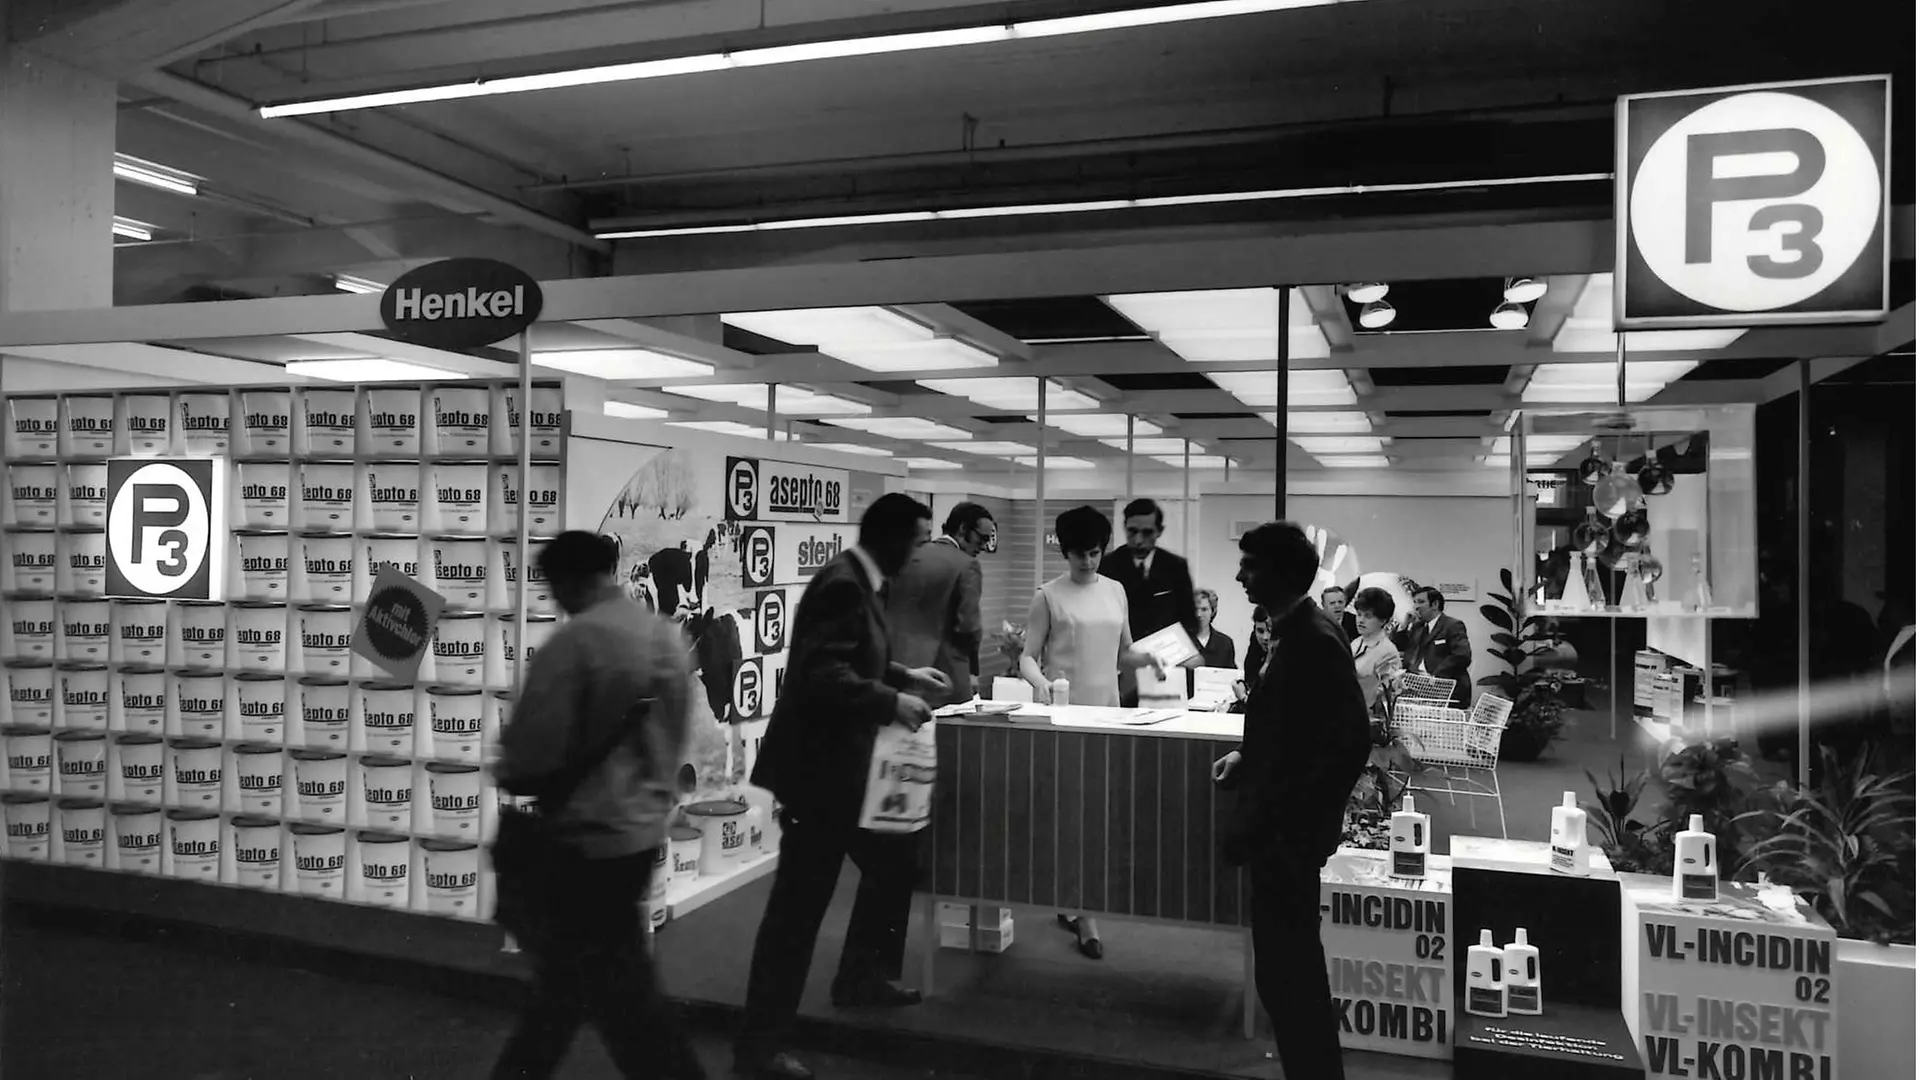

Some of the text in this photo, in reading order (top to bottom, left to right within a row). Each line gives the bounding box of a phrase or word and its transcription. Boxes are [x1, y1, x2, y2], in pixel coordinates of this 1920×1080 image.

[1684, 127, 1826, 279] P3
[395, 284, 524, 320] Henkel
[150, 418, 166, 429] 68
[272, 415, 288, 427] 68
[400, 414, 415, 425] 68
[473, 413, 488, 425] 68
[271, 486, 286, 497] 68
[339, 489, 352, 500] 68
[465, 489, 481, 501] 68
[542, 490, 557, 502] 68
[735, 468, 754, 511] P3
[769, 473, 841, 508] asepto 68
[131, 483, 190, 577] P3
[752, 537, 769, 578] P3
[764, 601, 780, 640] P3
[148, 625, 164, 636] 68
[209, 628, 224, 639] 68
[265, 630, 281, 641] 68
[739, 670, 758, 711] P3
[398, 713, 413, 725] 68
[330, 780, 344, 793] 68
[328, 855, 344, 867] 68
[391, 864, 407, 875] 68
[461, 872, 476, 885] 68
[1415, 934, 1446, 961] 02
[1645, 923, 1830, 975] VL-INCIDIN
[1331, 957, 1446, 1003] INSEKT
[1795, 976, 1830, 1003] 02
[1333, 997, 1446, 1044] KOMBI
[1644, 992, 1831, 1051] VL-INSEKT
[1645, 1035, 1831, 1080] VL-KOMBI
